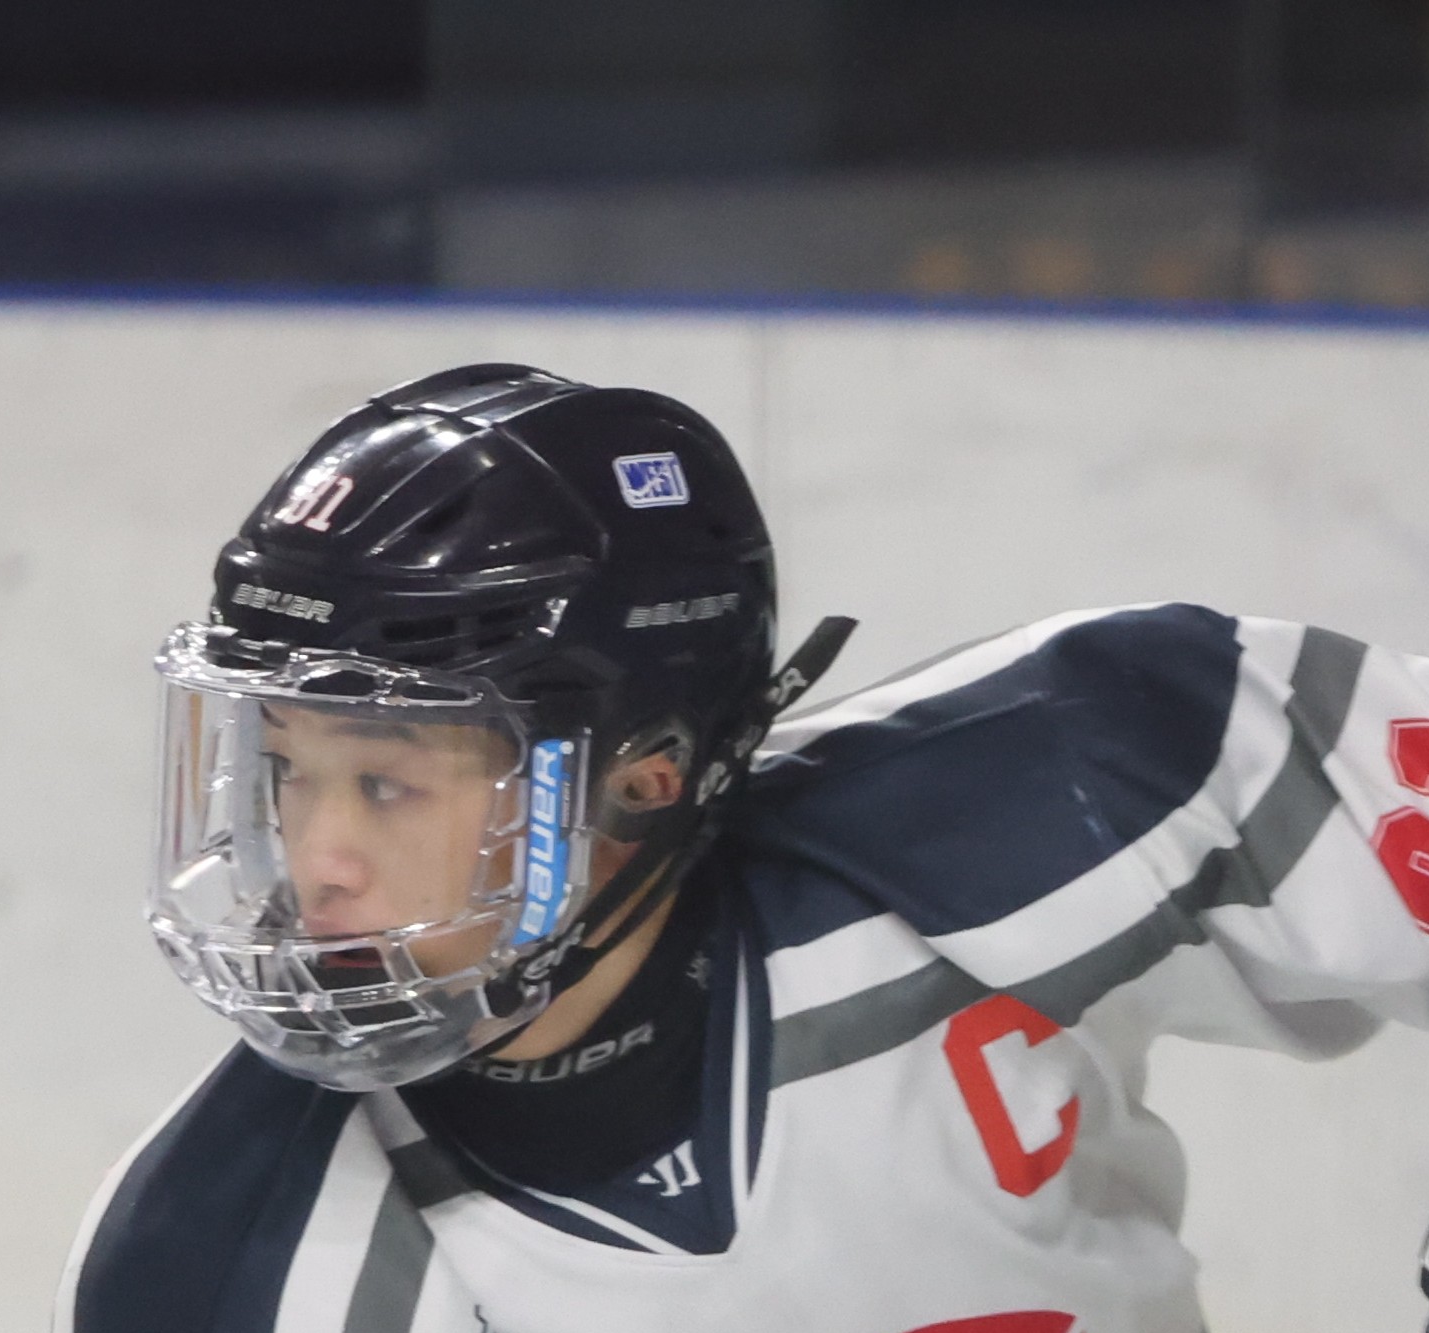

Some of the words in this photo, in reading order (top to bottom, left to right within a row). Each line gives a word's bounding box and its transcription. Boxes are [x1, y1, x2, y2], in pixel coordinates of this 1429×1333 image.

[231, 582, 336, 624] BAUER
[625, 592, 739, 629] BAUER
[942, 994, 1080, 1198] C
